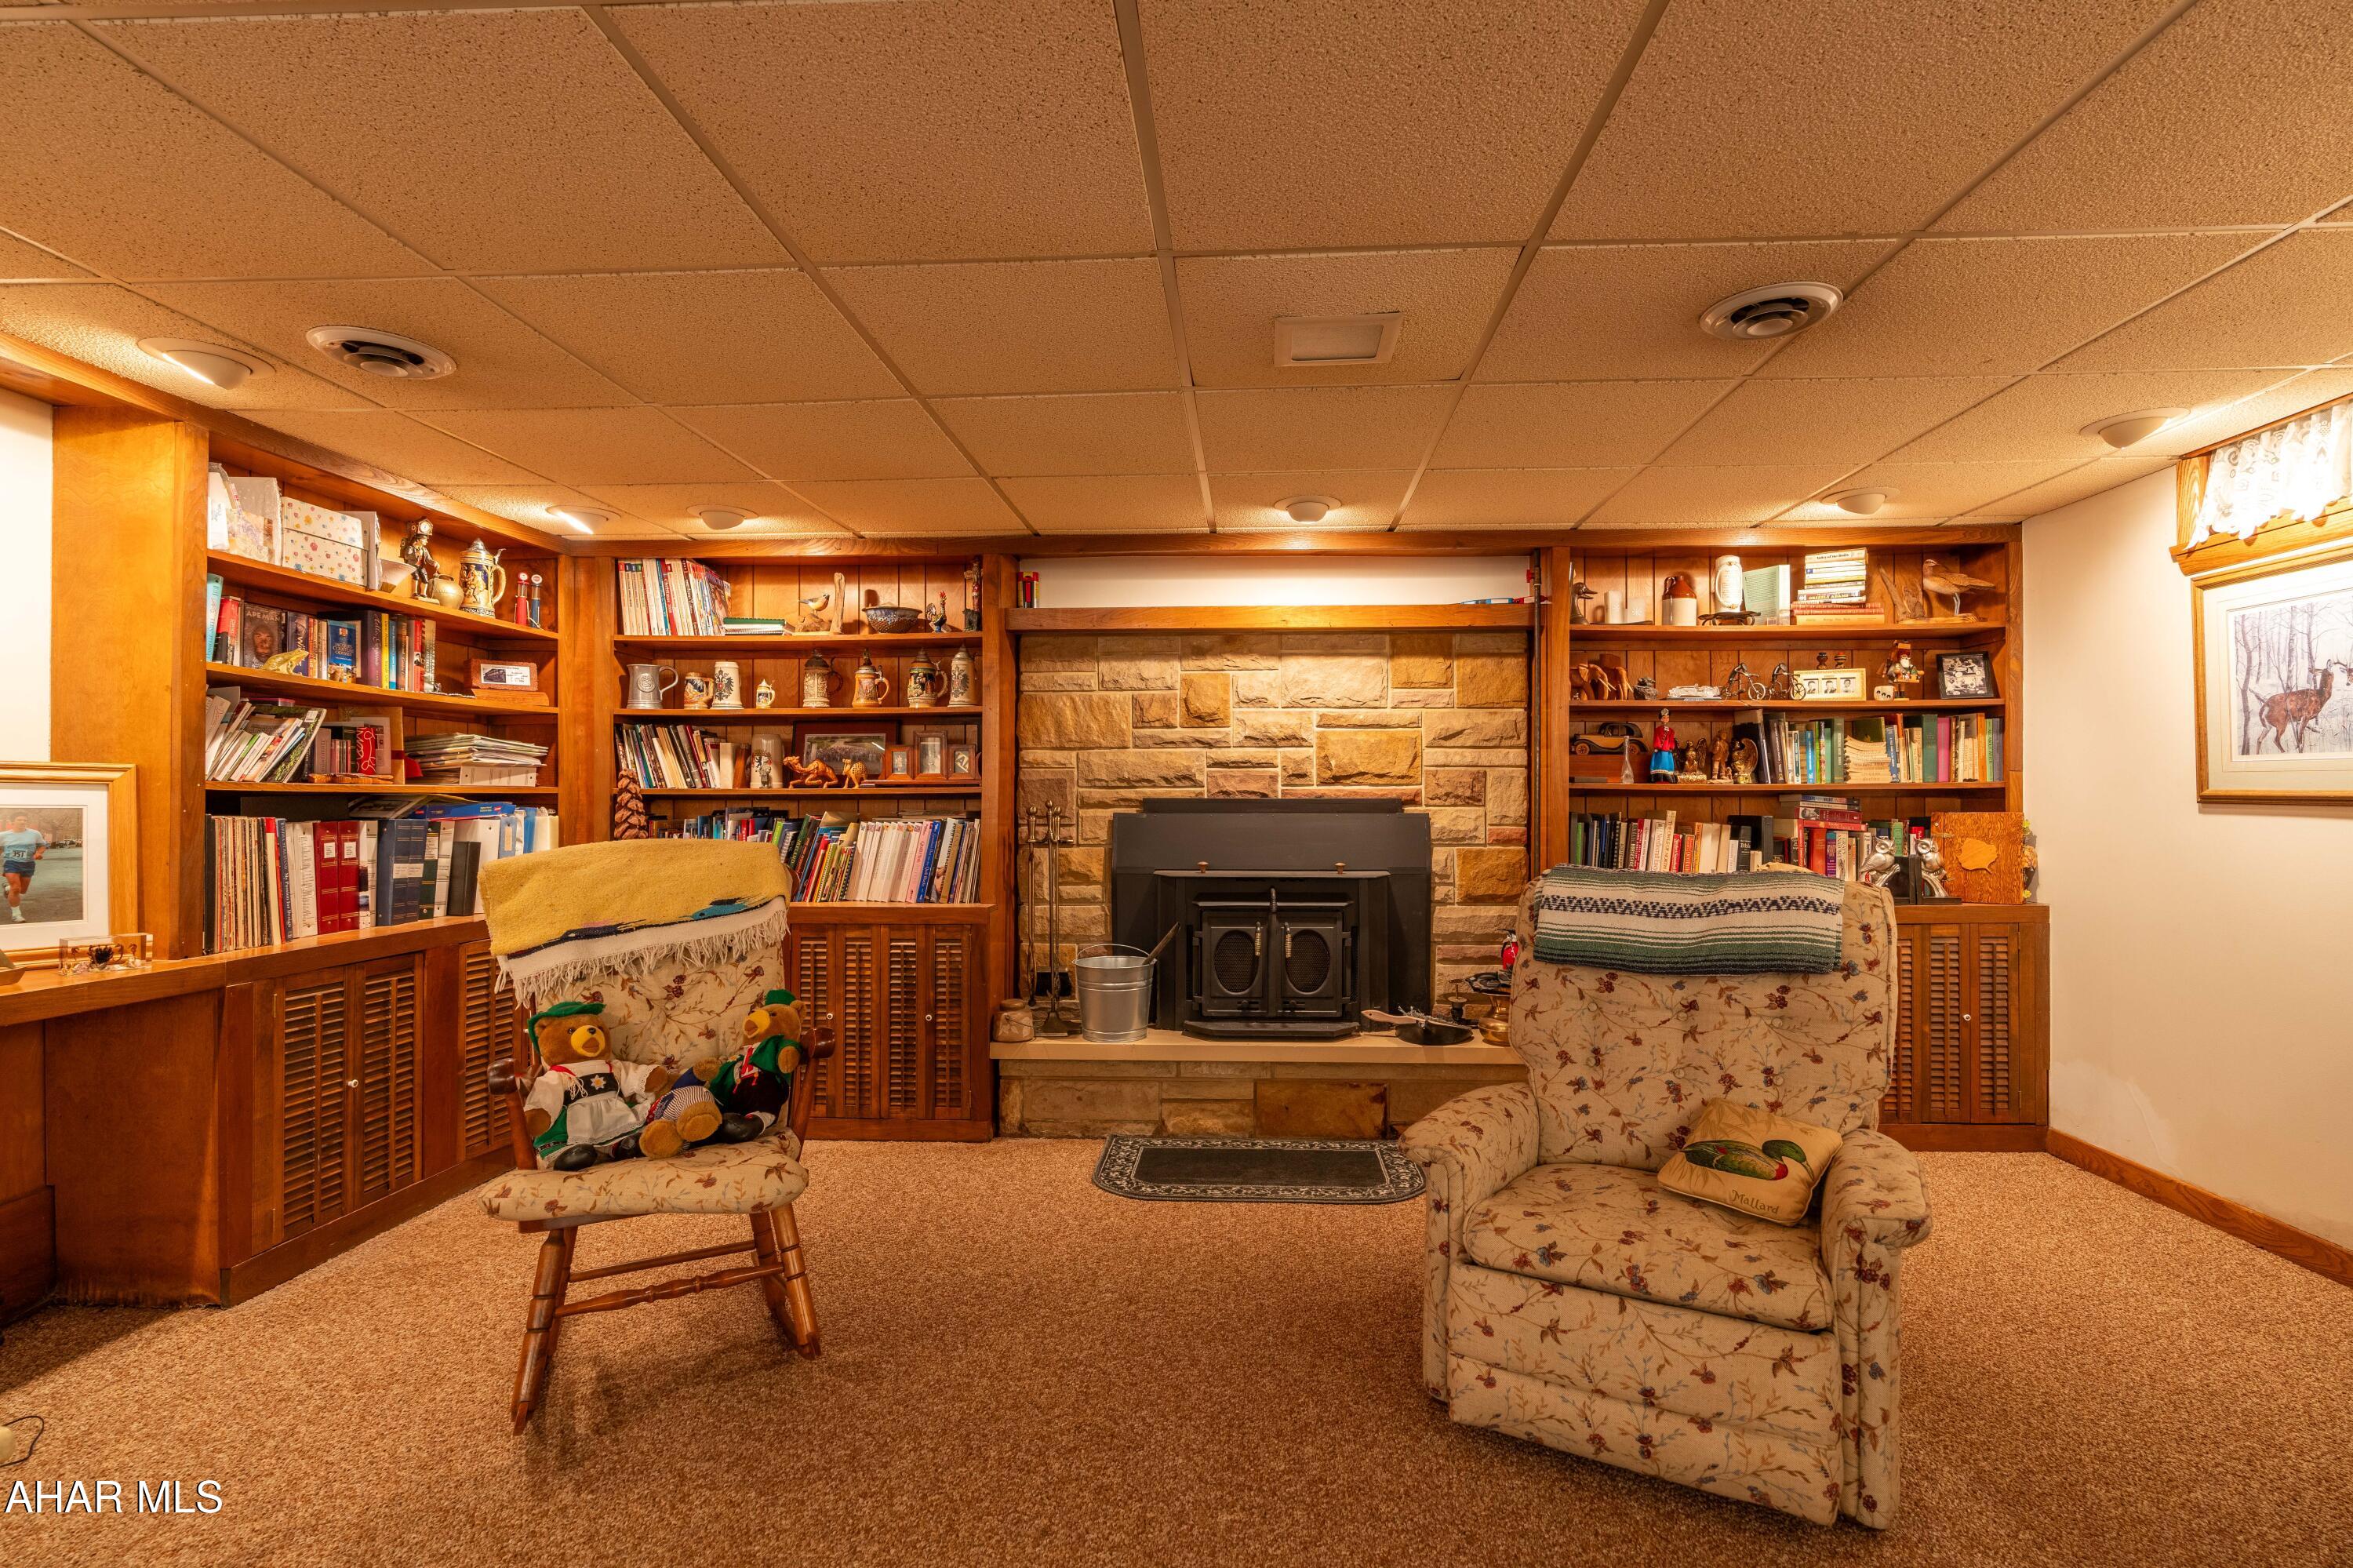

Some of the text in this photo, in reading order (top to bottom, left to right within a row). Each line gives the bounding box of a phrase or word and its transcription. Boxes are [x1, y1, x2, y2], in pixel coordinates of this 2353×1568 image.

[246, 611, 281, 623] APE MAN
[790, 839, 802, 864] IRELAND
[1732, 1189, 1779, 1214] Mallard
